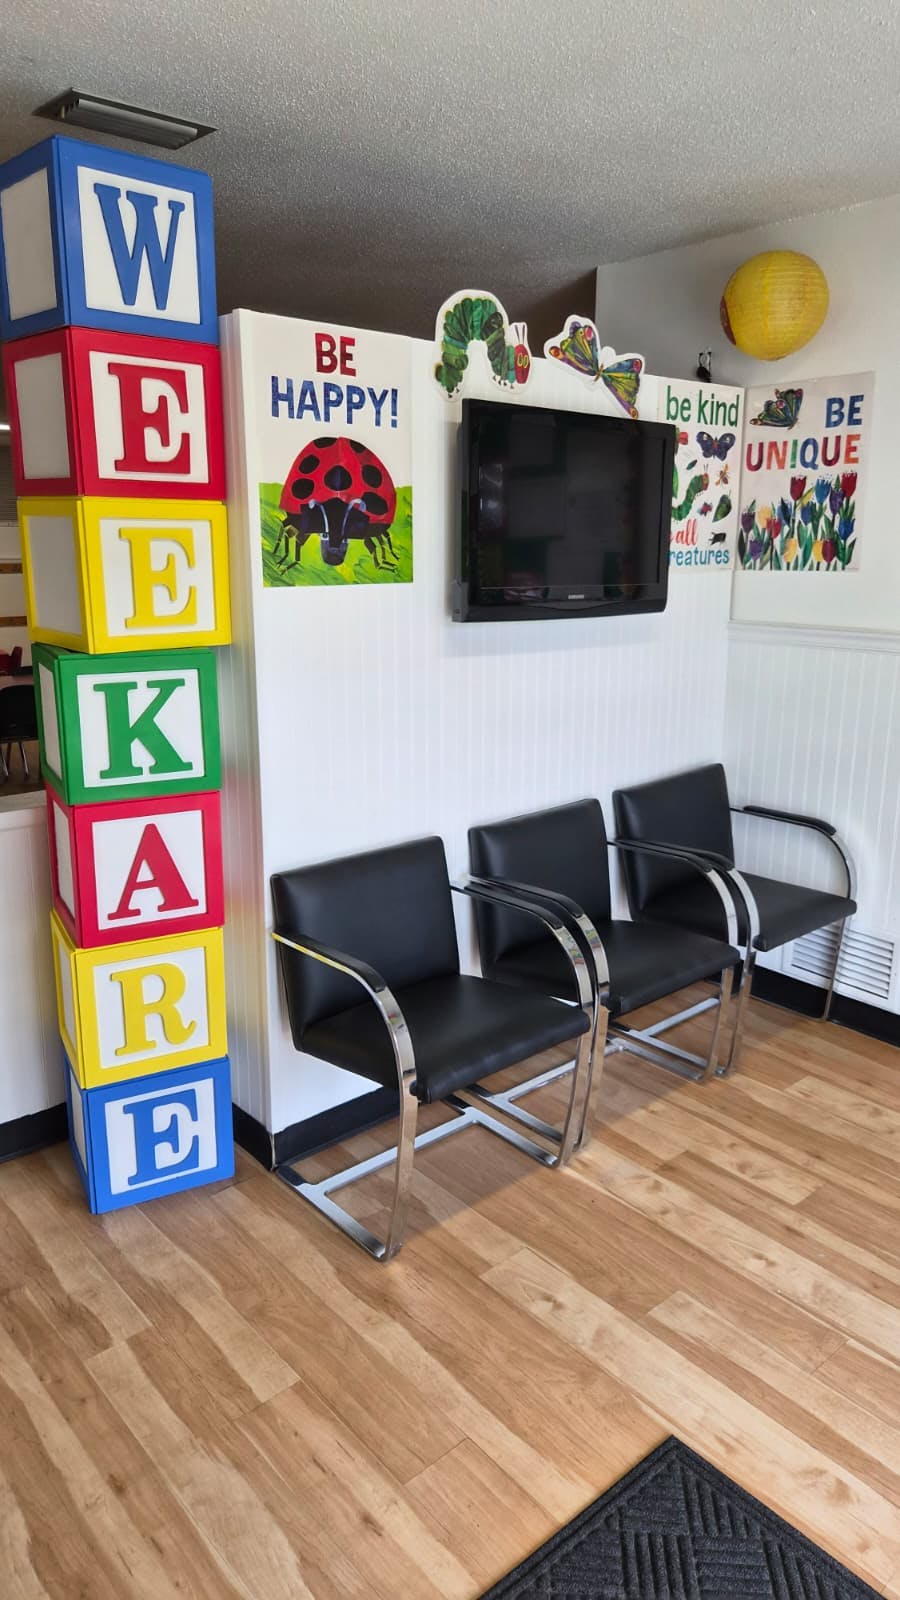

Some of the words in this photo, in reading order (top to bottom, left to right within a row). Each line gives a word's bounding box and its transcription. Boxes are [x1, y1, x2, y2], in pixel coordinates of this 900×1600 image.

[314, 332, 357, 377] BE
[270, 375, 399, 429] HAPPY!
[665, 385, 692, 421] be
[697, 389, 740, 427] kind
[825, 394, 865, 428] BE
[675, 518, 697, 546] all
[668, 546, 730, 566] reatures
